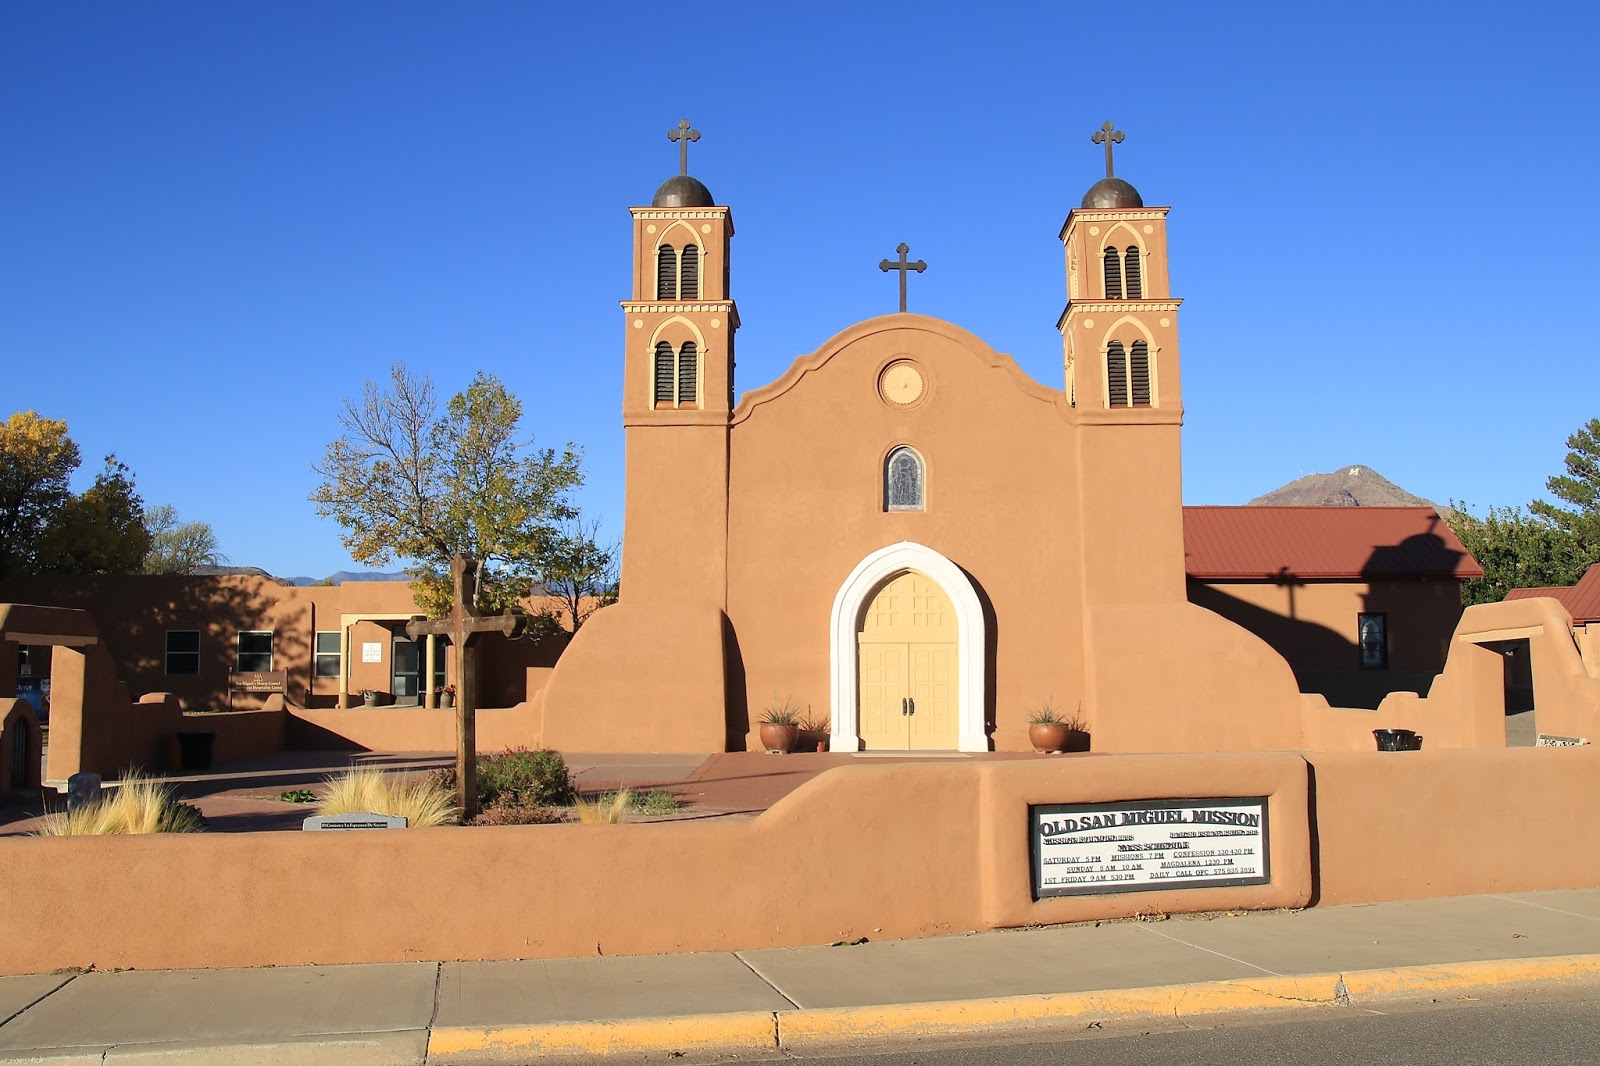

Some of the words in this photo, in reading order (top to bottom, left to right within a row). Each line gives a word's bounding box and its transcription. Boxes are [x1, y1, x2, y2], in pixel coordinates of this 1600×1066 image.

[1040, 819, 1078, 837] OLD
[1080, 813, 1116, 831] SAN
[1121, 809, 1187, 825] MIGUEL
[1191, 810, 1260, 827] MISSION
[1043, 837, 1078, 846] MISSION
[1117, 844, 1143, 852] MASS
[1043, 856, 1080, 865] SATURDAY
[1111, 853, 1144, 861] MISSIONS
[1173, 849, 1215, 858] CONFESSION
[1066, 865, 1094, 874] SUNDAY
[1160, 860, 1201, 868] MAGDALENA
[1061, 875, 1089, 883] FRIDAY
[1149, 871, 1170, 879] DAILY
